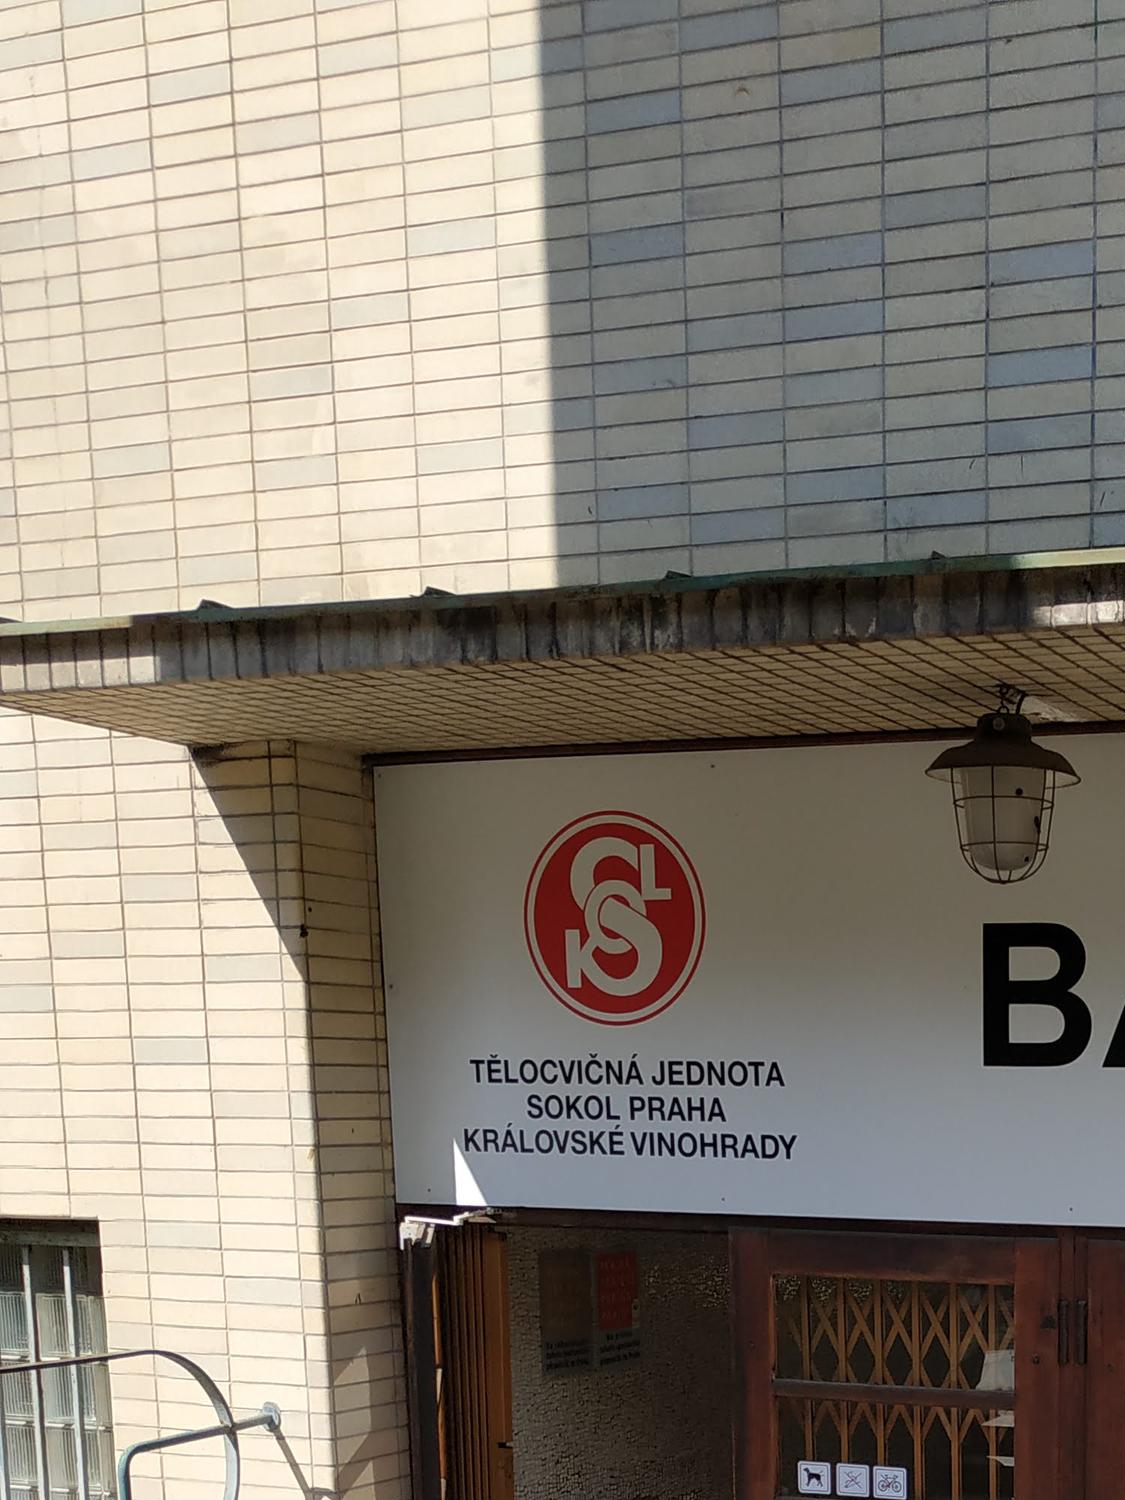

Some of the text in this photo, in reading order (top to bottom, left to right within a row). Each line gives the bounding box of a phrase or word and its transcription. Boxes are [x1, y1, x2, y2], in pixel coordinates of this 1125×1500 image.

[470, 1053, 786, 1087] TĚLOCVIČNÁ JEDNOTA
[527, 1094, 727, 1123] SOKOL PRAHA
[463, 1123, 799, 1160] KRÁLOVSKÉ VINOHRADY
